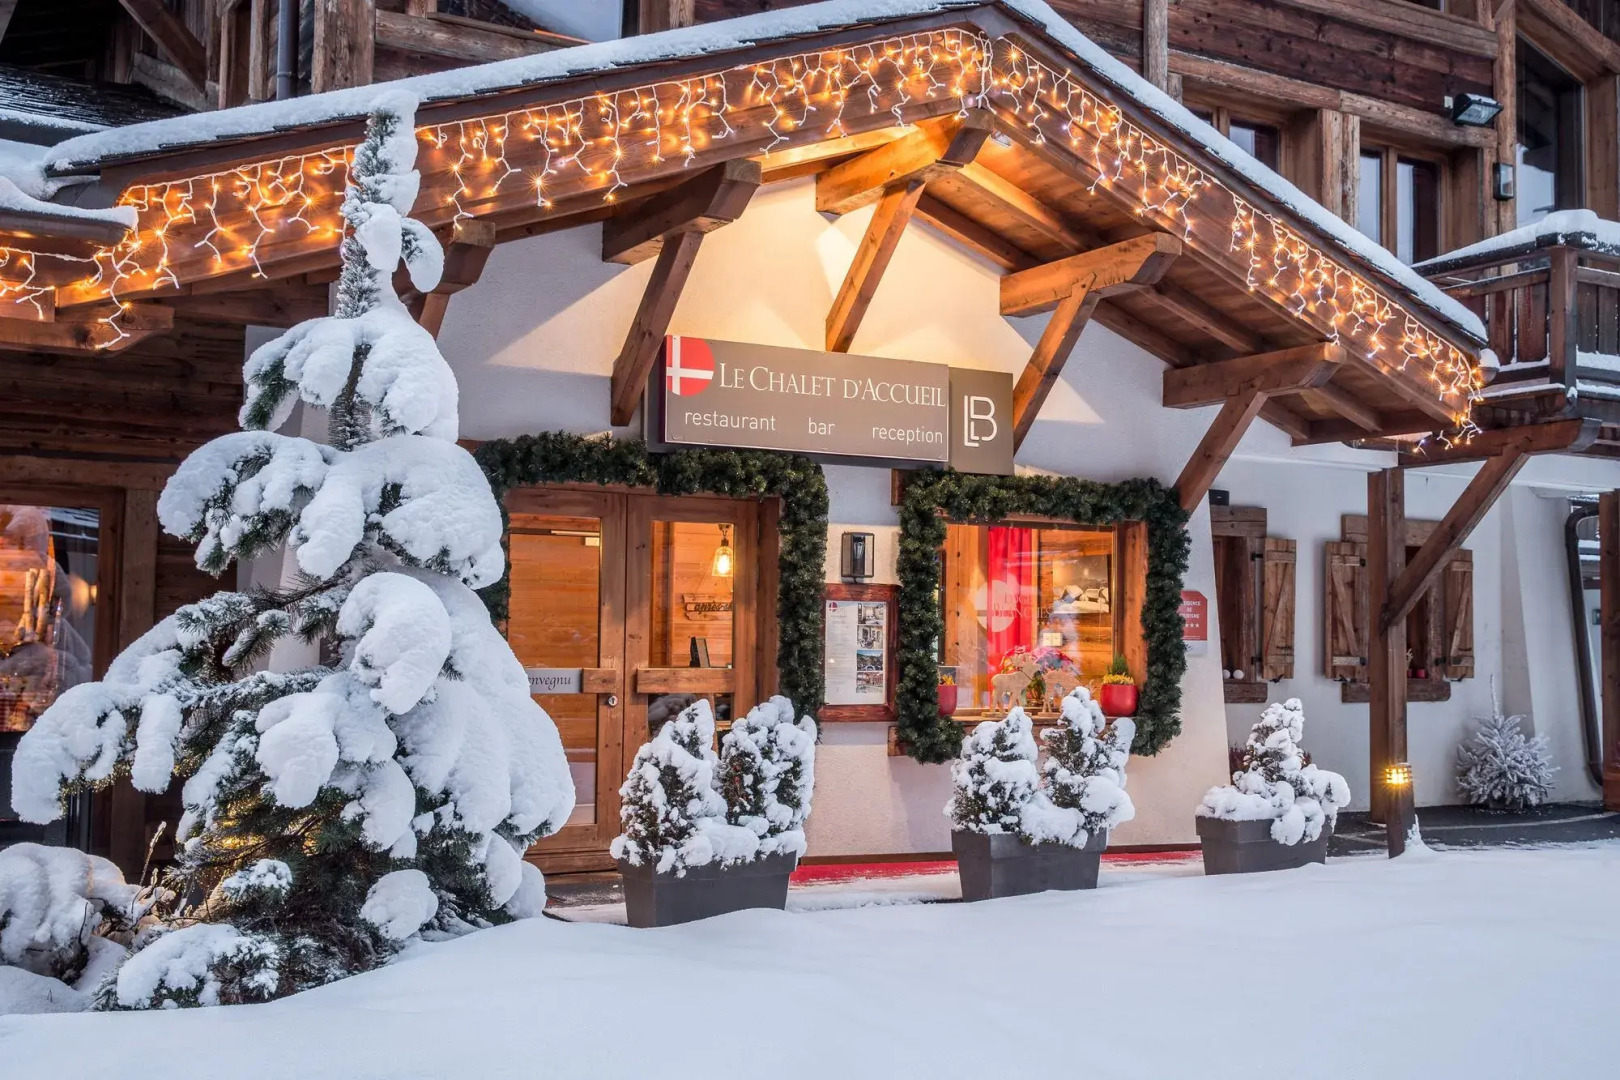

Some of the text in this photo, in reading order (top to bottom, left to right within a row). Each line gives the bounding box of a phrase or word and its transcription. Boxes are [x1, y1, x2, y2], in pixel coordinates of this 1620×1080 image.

[749, 366, 837, 397] CHALET
[684, 411, 944, 445] restaurant bar reception
